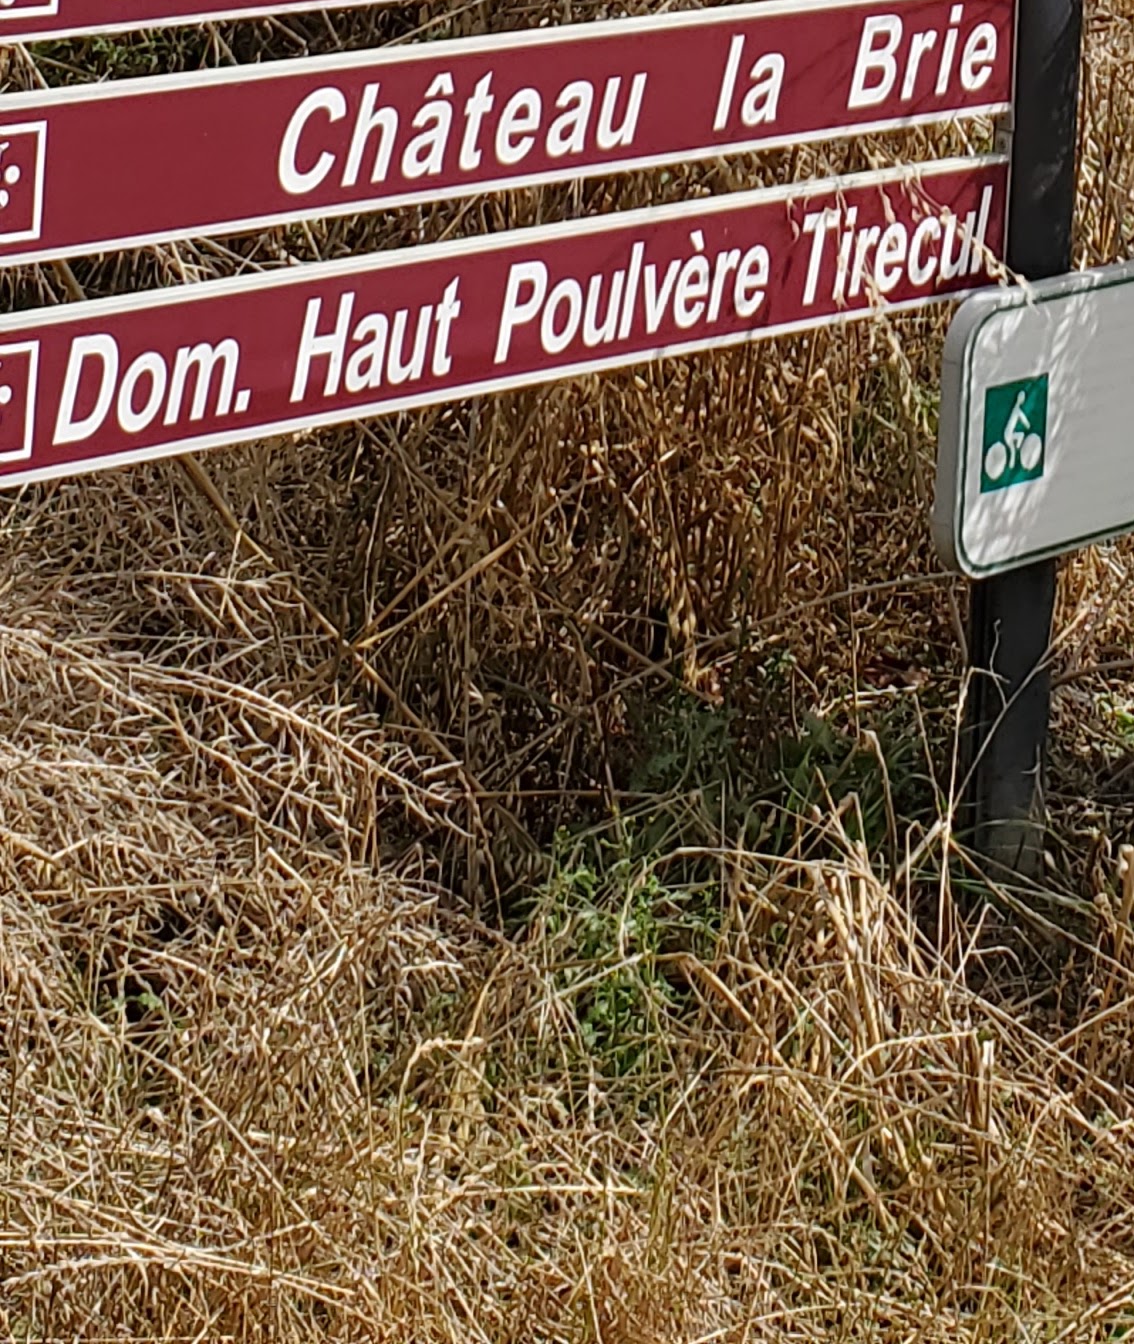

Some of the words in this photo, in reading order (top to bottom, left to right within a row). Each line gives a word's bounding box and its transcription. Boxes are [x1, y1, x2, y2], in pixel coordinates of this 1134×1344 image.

[278, 71, 647, 195] Château
[713, 34, 785, 131] la
[847, 4, 997, 109] Brie
[52, 333, 251, 446] Dom.
[289, 276, 461, 403] Haut
[494, 229, 770, 364] Poulvère
[802, 184, 994, 306] Tirecul
